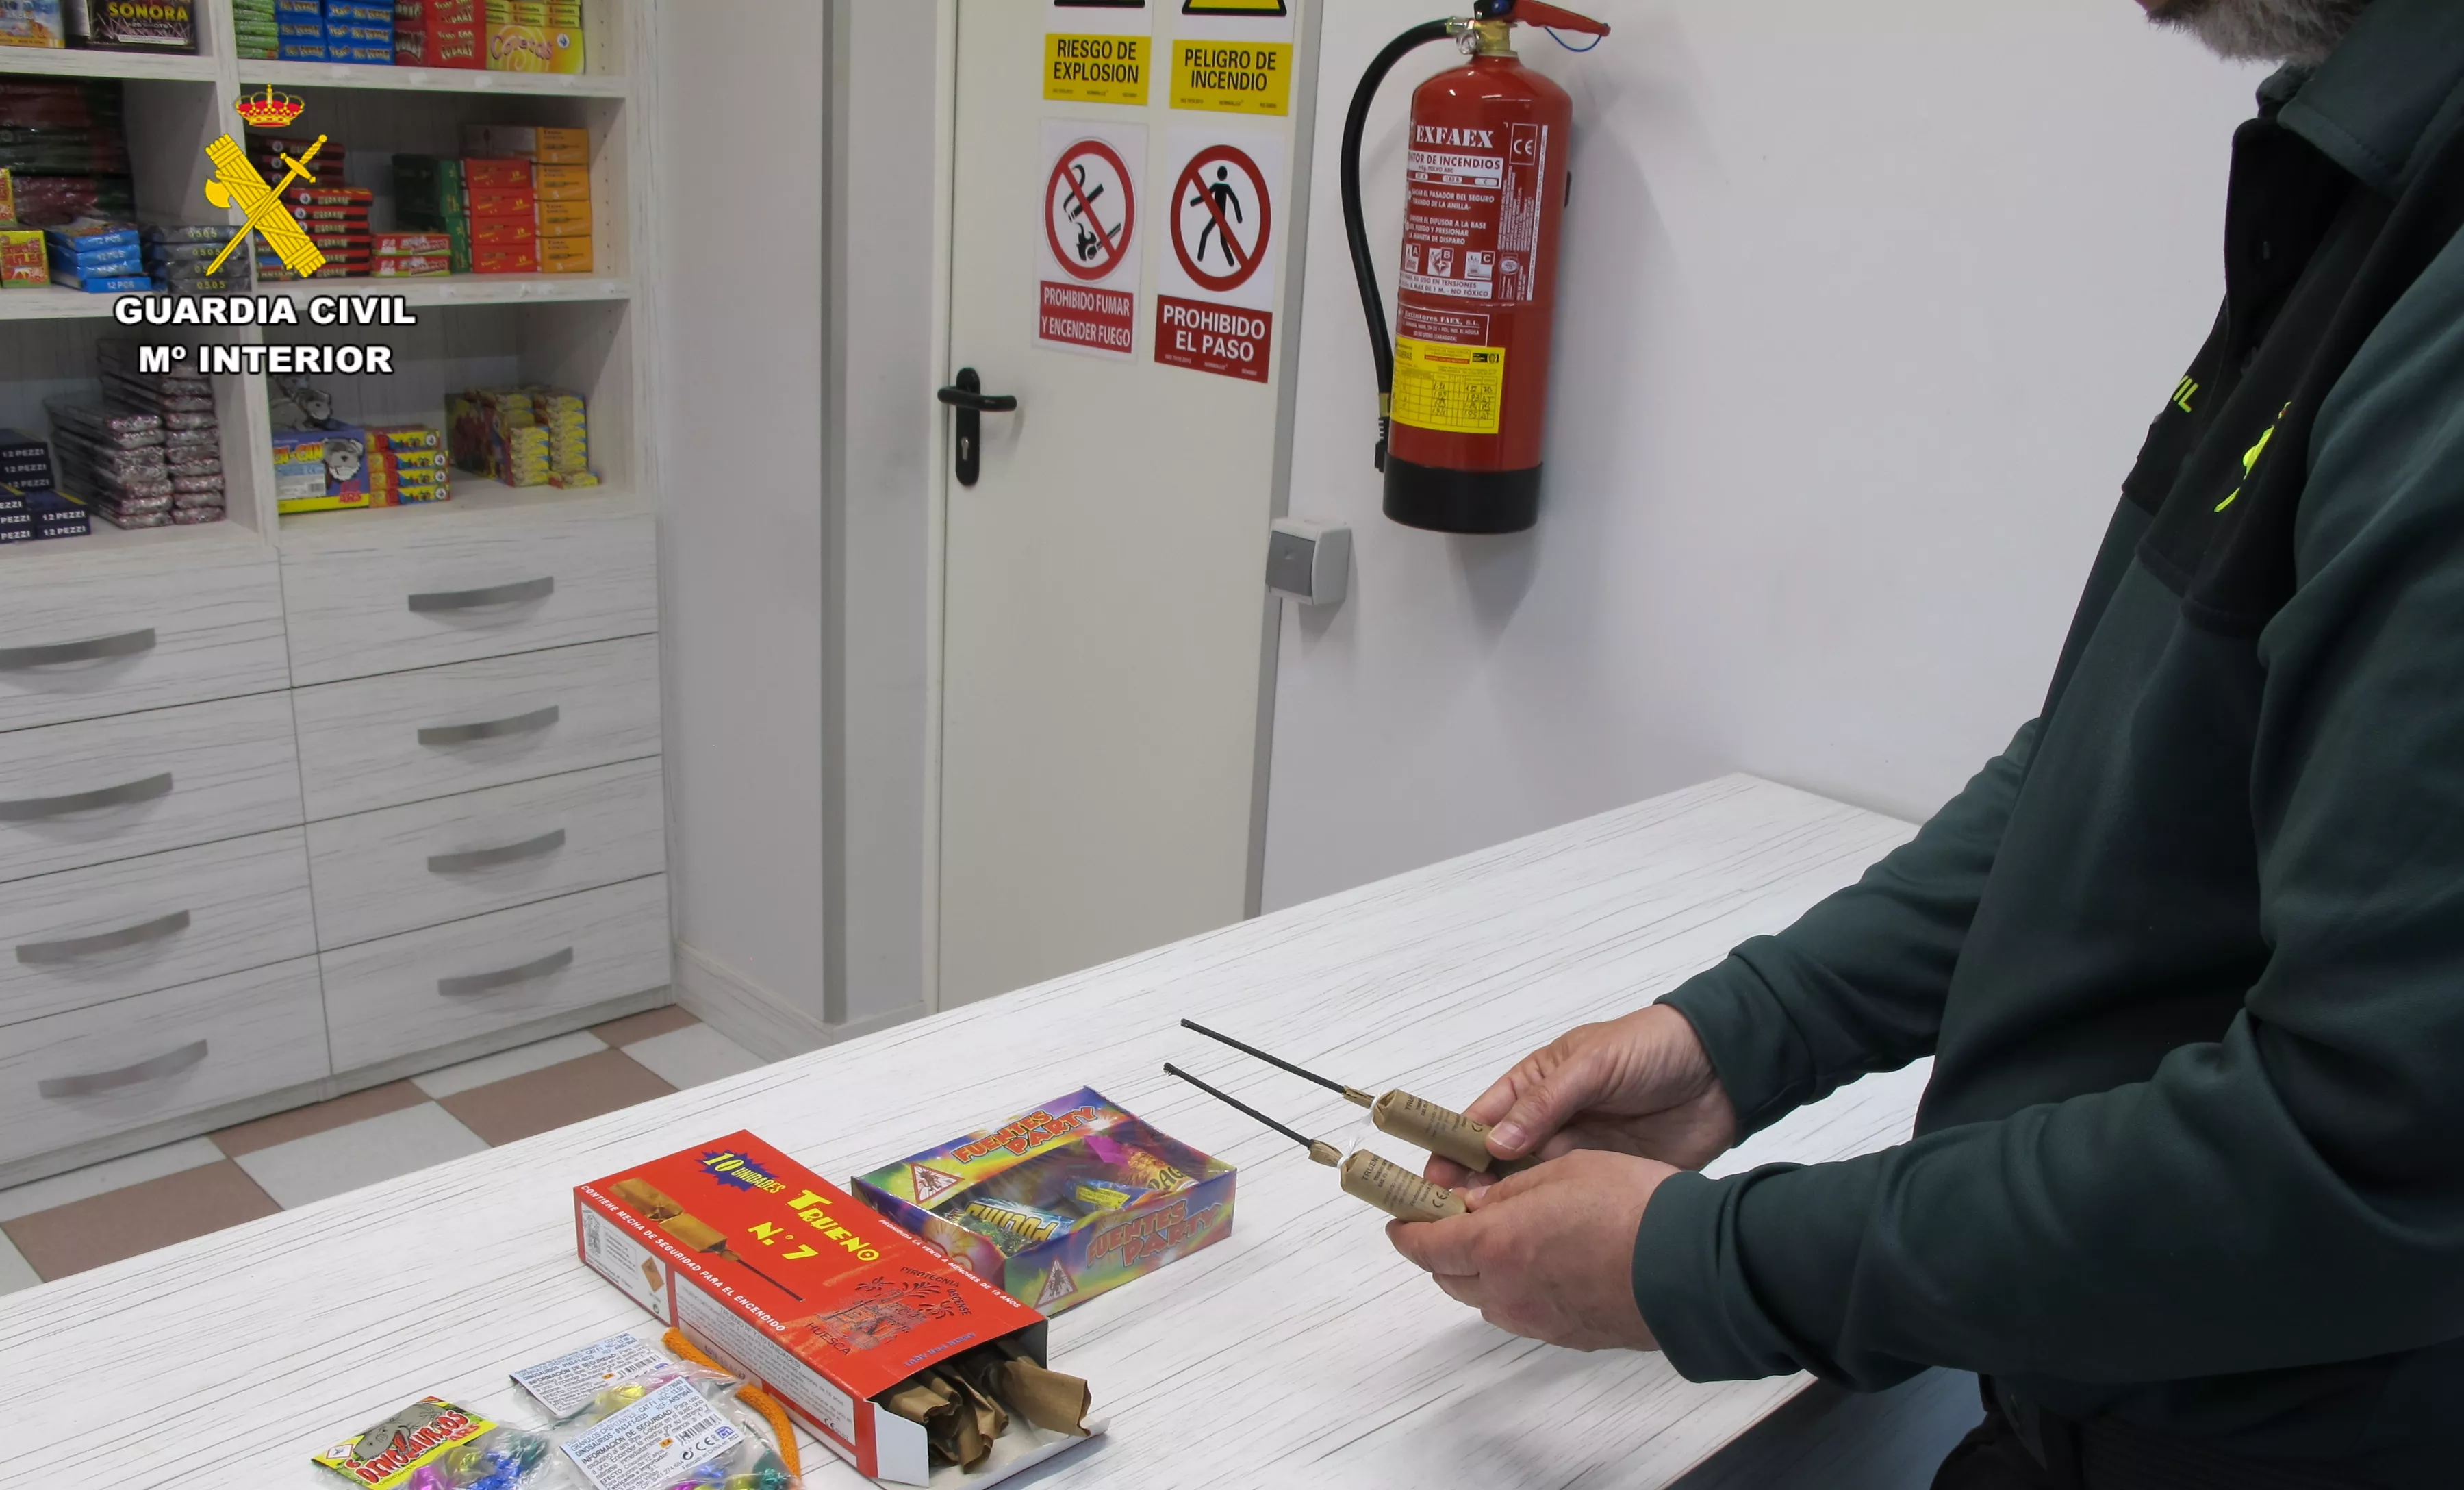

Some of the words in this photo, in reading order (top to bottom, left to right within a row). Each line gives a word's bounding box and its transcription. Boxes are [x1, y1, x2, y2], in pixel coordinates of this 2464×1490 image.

[109, 2, 188, 21] SONORA
[490, 34, 553, 60] Coletas
[1057, 39, 1113, 59] RIESGO
[1117, 42, 1136, 60] DE
[1184, 49, 1251, 69] PELIGRO
[1256, 52, 1277, 71] DE
[1054, 62, 1139, 84] EXPLOSION
[1191, 71, 1267, 91] INCENDIO
[1417, 125, 1493, 149] EXFAEX
[1513, 138, 1534, 155] CE
[1427, 154, 1437, 164] DE
[1440, 155, 1501, 170] INCENDIOS
[1429, 190, 1455, 200] PASADOR
[1456, 192, 1466, 201] DEL
[1469, 194, 1495, 203] SEGURO
[1430, 217, 1453, 226] DIFUSOR
[1435, 227, 1469, 236] PRESIONAR
[1439, 236, 1465, 245] DISPARO
[1443, 251, 1451, 260] B
[1483, 254, 1491, 263] C
[117, 280, 134, 289] PCS
[197, 281, 225, 290] 0505
[1442, 279, 1477, 288] TENSIONES
[1044, 286, 1094, 311] PROHIBIDO
[1097, 292, 1130, 316] FUMAR
[1163, 305, 1265, 340] PROHIBIDO
[1404, 310, 1438, 322] Extintores
[1041, 316, 1048, 333] Y
[1049, 318, 1096, 342] ENCENDER
[1098, 324, 1130, 347] FUEGO
[1176, 331, 1196, 352] EL
[1202, 336, 1254, 362] PASO
[15, 449, 45, 457] PEZZI
[18, 464, 47, 472] PEZZI
[21, 479, 49, 488] PEZZI
[1, 514, 31, 524] PEZZI
[56, 510, 86, 520] PEZZI
[1, 530, 31, 540] PEZZI
[56, 525, 86, 535] PEZZI
[952, 1110, 1055, 1163] FUENTES
[1006, 1106, 1099, 1157] PARTY
[702, 1152, 745, 1172] 10
[731, 1167, 786, 1194] UNIDADES
[787, 1189, 880, 1261] TRUENO
[1087, 1198, 1188, 1270] FUENTES
[1121, 1203, 1223, 1268] PARTY
[581, 1185, 620, 1212] CONTIENE
[617, 1210, 644, 1232] MECHA
[643, 1230, 657, 1242] DE
[655, 1238, 702, 1272] SEGURIDAD
[700, 1270, 724, 1289] PARA
[722, 1286, 734, 1297] EL
[733, 1295, 785, 1333] ENCENDIDO
[781, 1243, 819, 1261] 7
[878, 1218, 913, 1241] PROHIBIDA
[911, 1237, 922, 1246] LA
[921, 1241, 941, 1259] VENTA
[948, 1261, 981, 1284] MENORES
[979, 1280, 991, 1291] DE
[991, 1287, 1001, 1298] 18
[1000, 1291, 1021, 1309] AÑOS
[900, 1265, 960, 1287] PIROTECNIA
[805, 1322, 852, 1356] HUESCA
[637, 1403, 651, 1413] CAT
[579, 1434, 627, 1465] INFORMACIÓN
[624, 1428, 637, 1439] DE
[672, 1400, 689, 1411] Para
[640, 1419, 665, 1436] Colocar
[574, 1432, 615, 1458] DINOSAURIOS
[608, 1443, 638, 1463] Encender
[642, 1428, 664, 1442] mecha
[696, 1436, 715, 1451] CE
